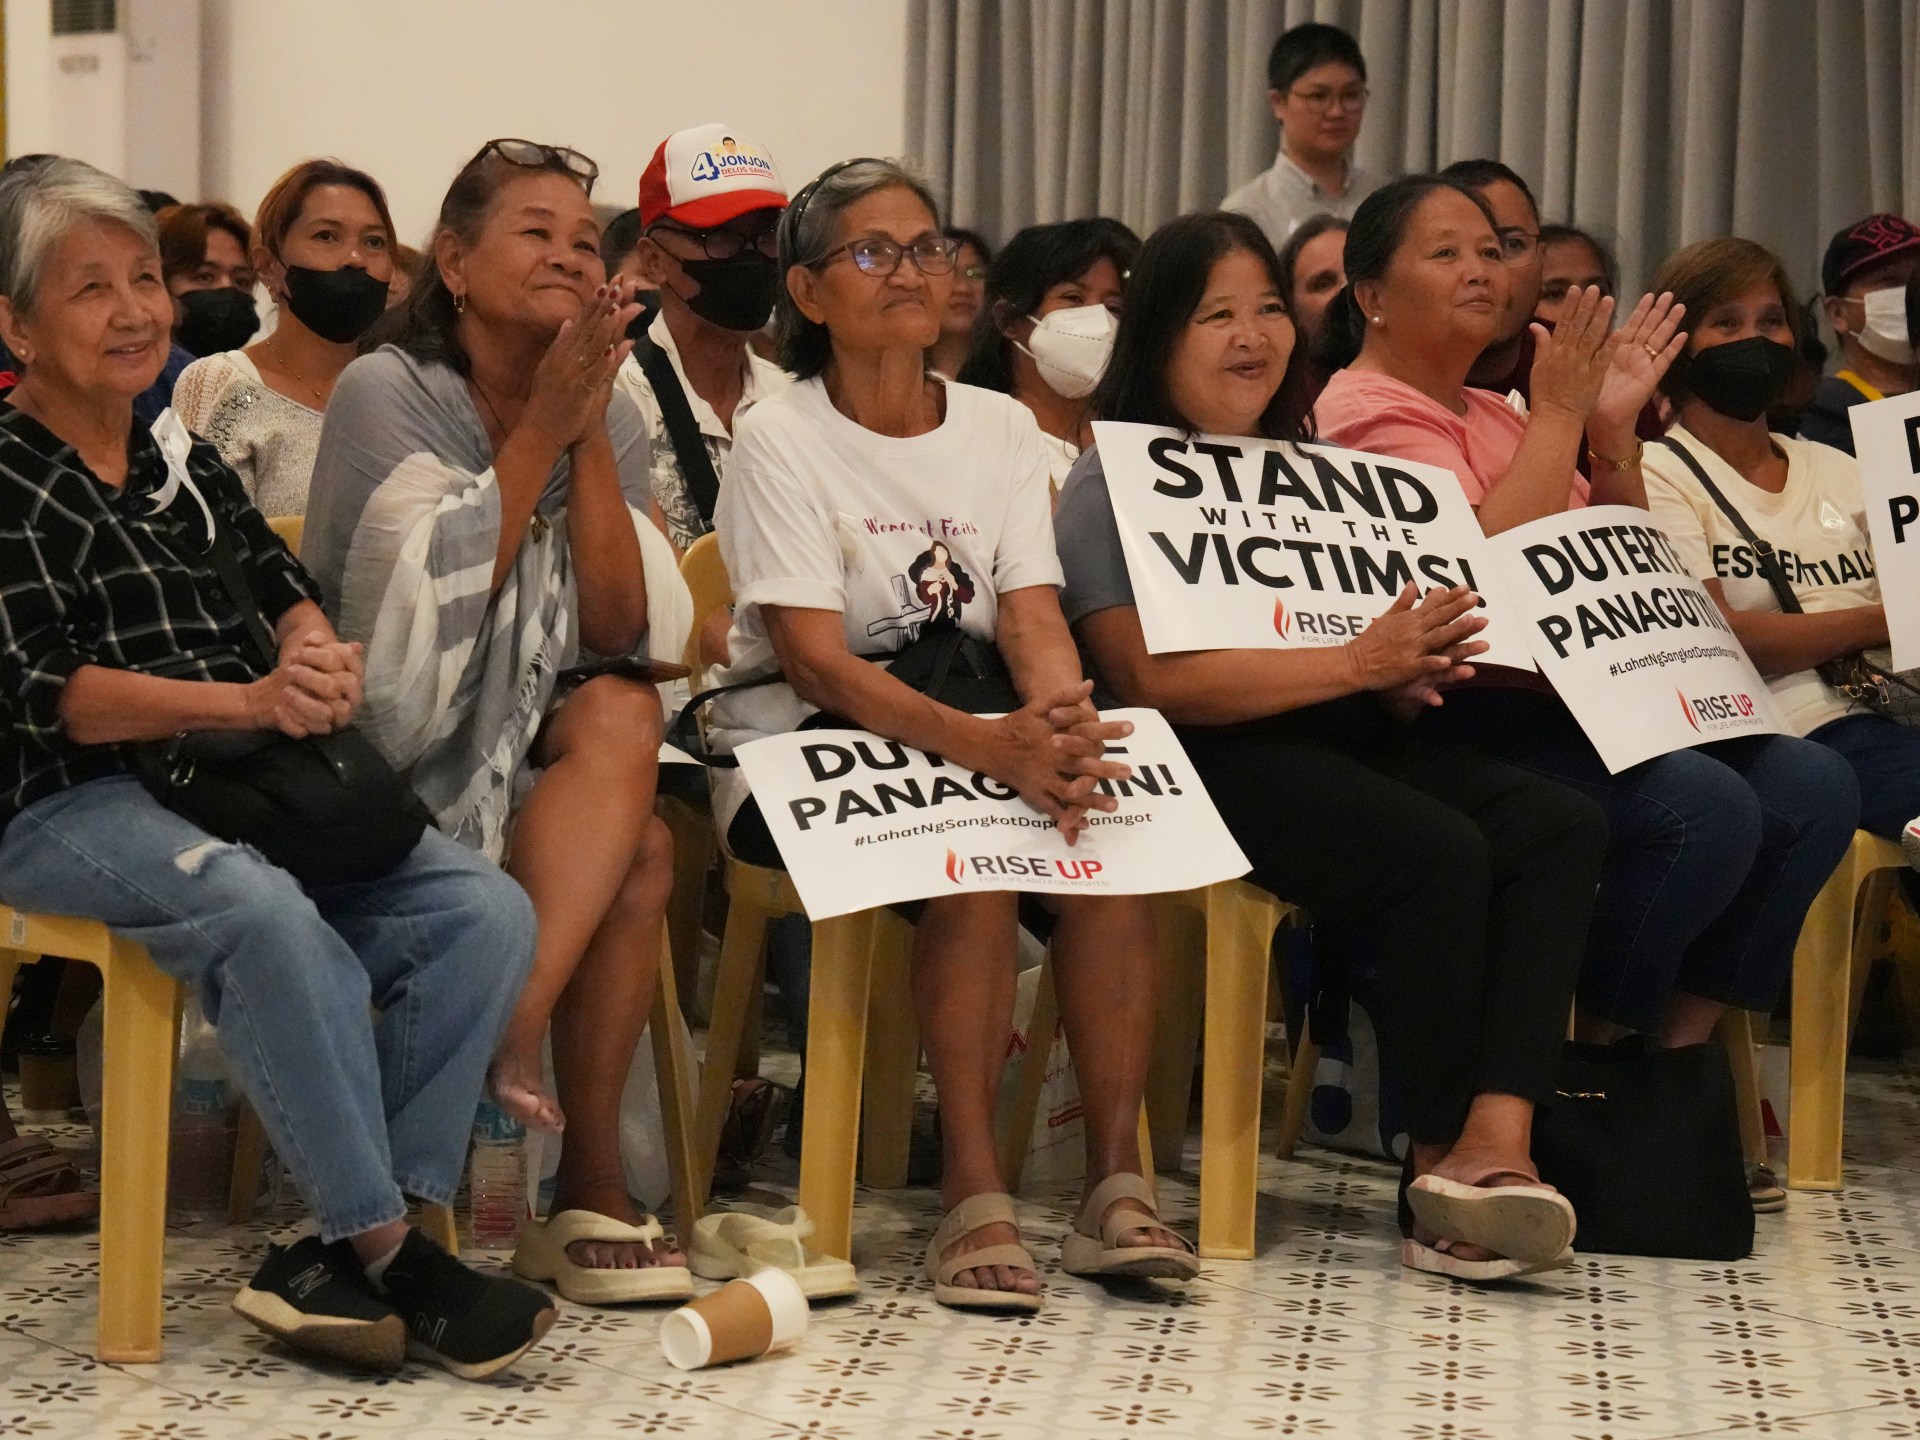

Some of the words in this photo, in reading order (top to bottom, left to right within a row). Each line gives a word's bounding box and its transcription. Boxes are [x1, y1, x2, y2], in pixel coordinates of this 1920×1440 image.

[691, 152, 720, 181] 4
[719, 155, 771, 170] JONJON
[721, 166, 748, 175] DELOS
[1147, 437, 1439, 524] STAND
[863, 517, 914, 535] Women
[919, 520, 934, 538] of
[939, 517, 979, 538] Faith
[1199, 506, 1311, 534] WITH
[1342, 520, 1418, 546] THE
[1148, 531, 1487, 608] VICTIMS!
[1521, 525, 1692, 596] DUTERTE
[1295, 611, 1363, 636] RISE
[1301, 635, 1320, 643] FOR
[1321, 636, 1340, 645] LIFE
[1692, 695, 1738, 722] RISE
[1731, 694, 1755, 717] UP
[788, 764, 1183, 831] PANAGIN!
[854, 813, 1152, 847] #LahatNgSangkotDapanagot
[970, 855, 1052, 877] RISE
[1055, 860, 1103, 879] UP
[287, 1263, 333, 1299] N
